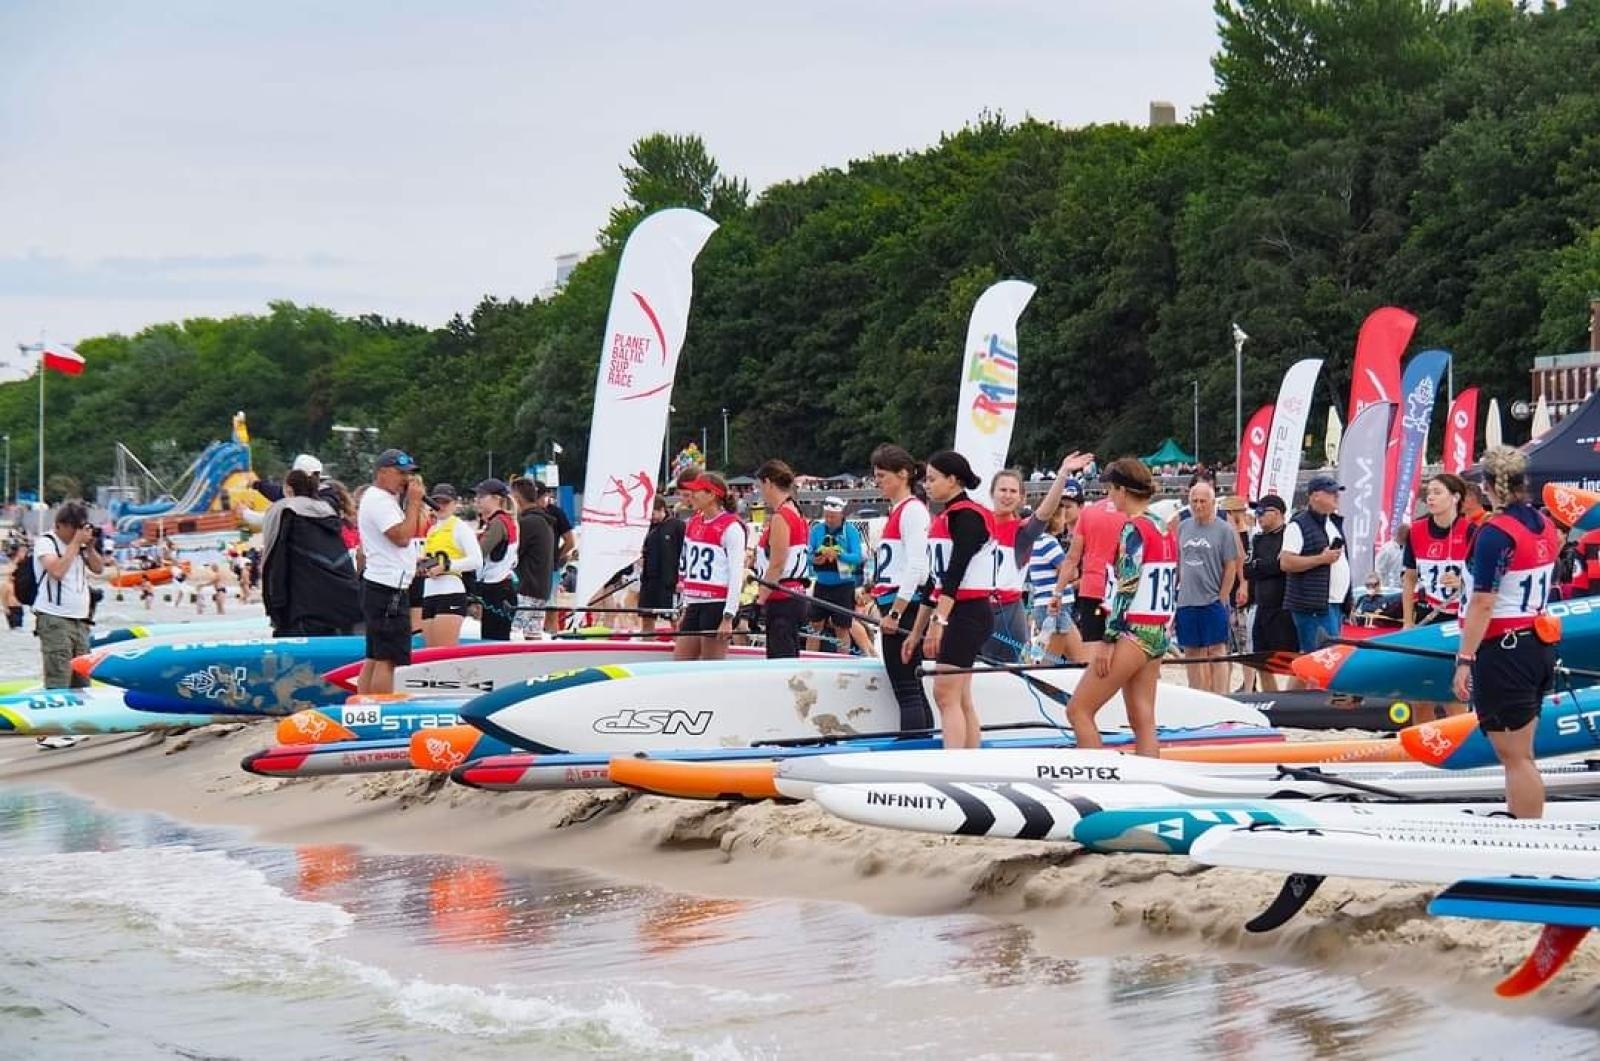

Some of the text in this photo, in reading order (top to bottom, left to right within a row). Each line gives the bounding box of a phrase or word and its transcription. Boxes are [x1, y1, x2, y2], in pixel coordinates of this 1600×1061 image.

[614, 333, 650, 352] PLANET
[611, 346, 645, 364] BALTIC
[609, 359, 629, 373] SUP
[607, 370, 633, 388] RACE
[1353, 456, 1374, 560] TEAM
[1519, 571, 1546, 612] 11
[345, 711, 377, 725] 048
[593, 709, 713, 735] NSP
[867, 790, 947, 810] INFINITY
